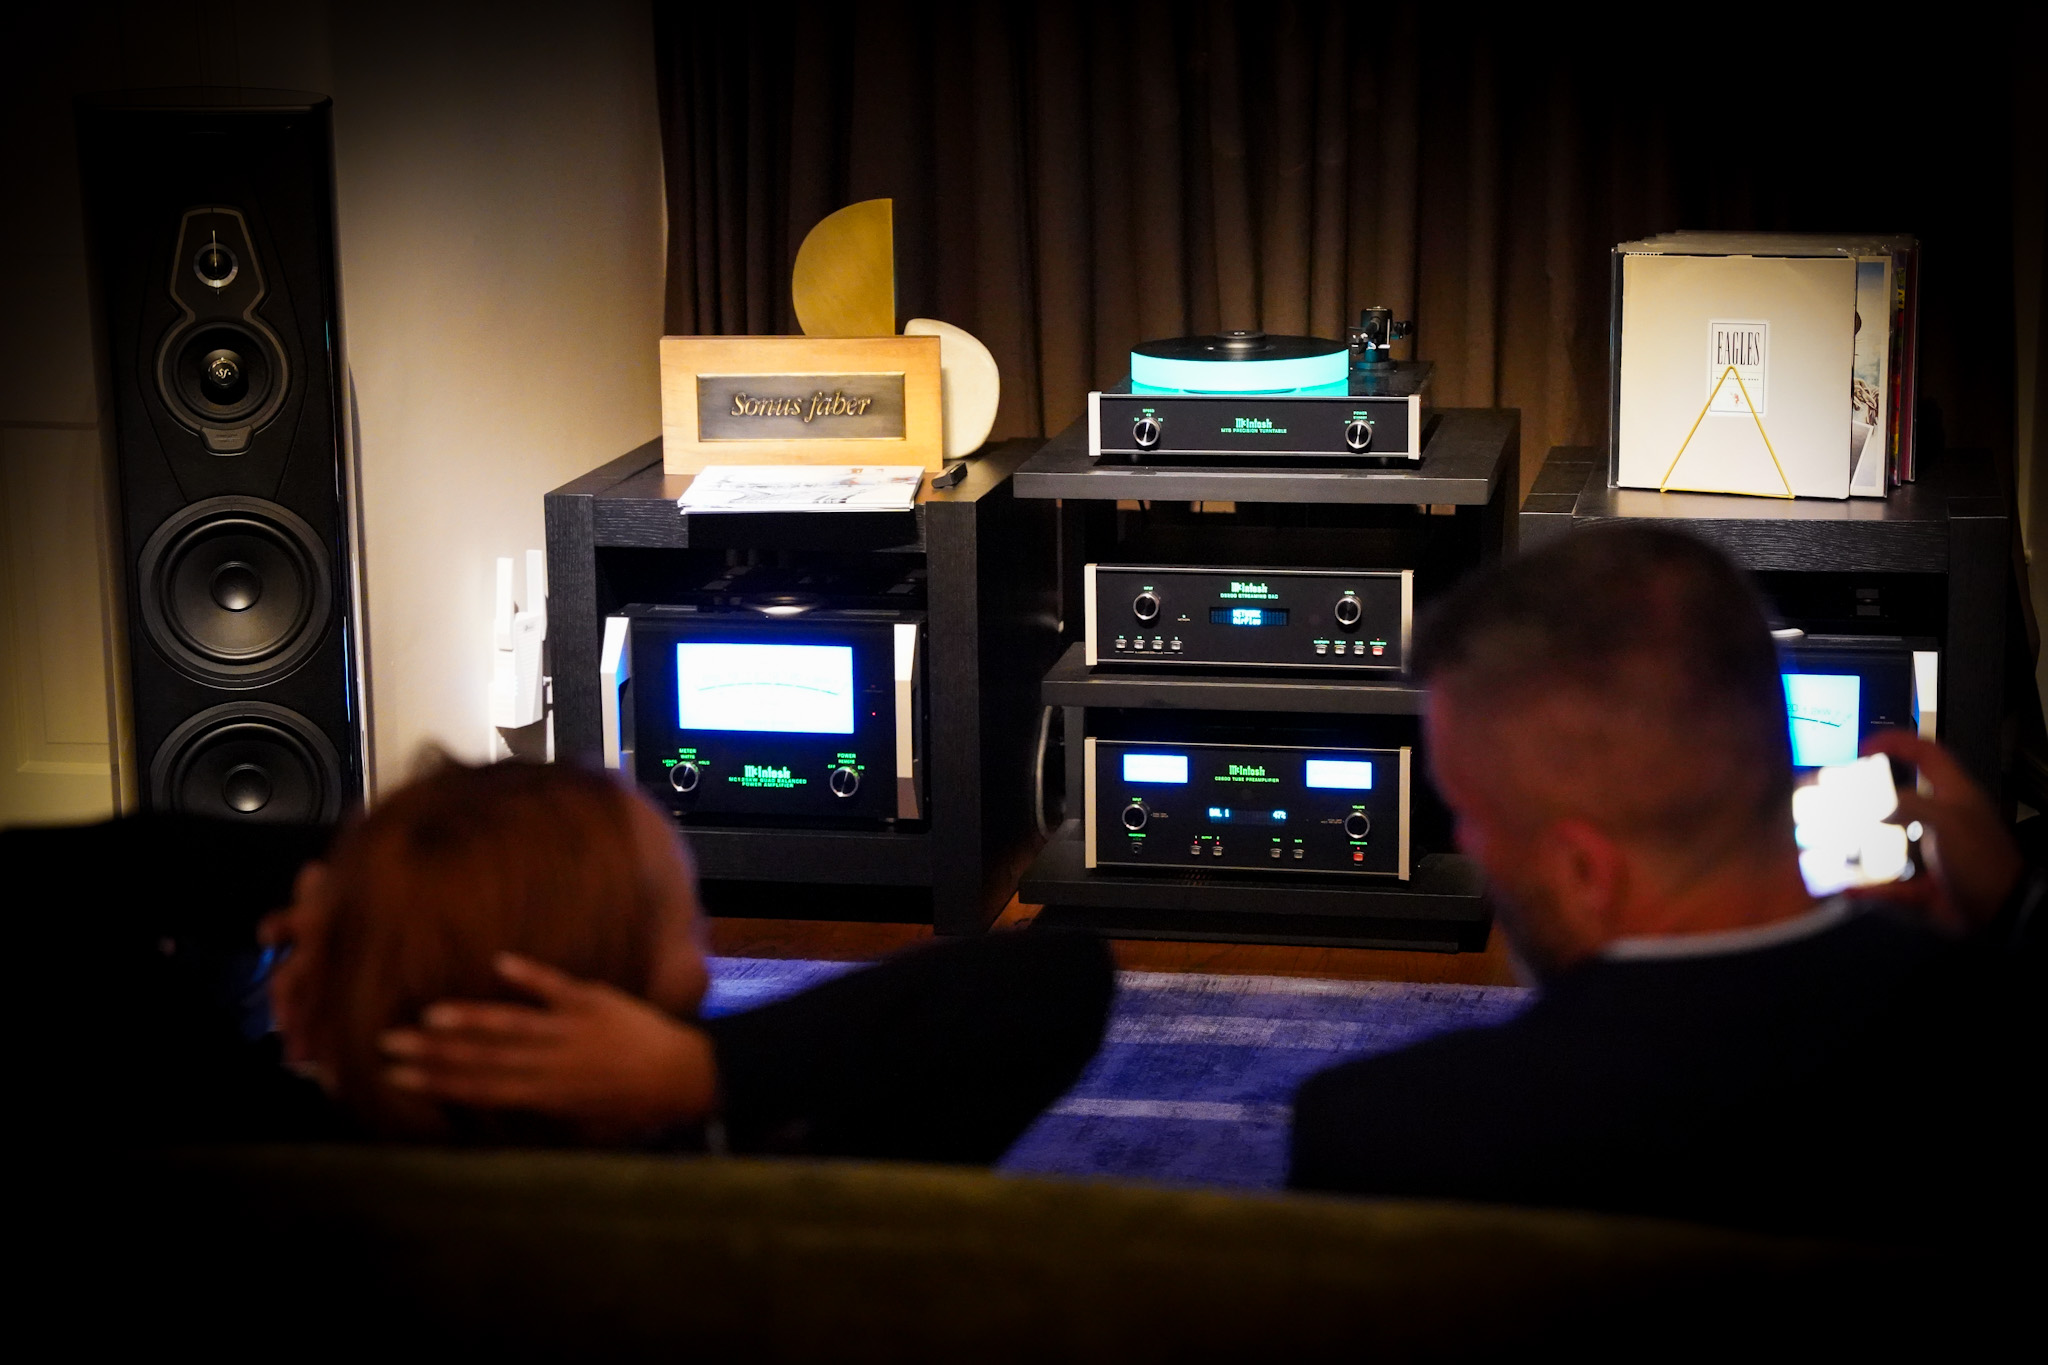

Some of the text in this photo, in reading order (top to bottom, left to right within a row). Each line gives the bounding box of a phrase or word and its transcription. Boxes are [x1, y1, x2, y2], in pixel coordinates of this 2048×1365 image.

[1717, 331, 1760, 366] EAGLES
[731, 390, 872, 424] Sonus faber
[1235, 418, 1272, 428] McIntosh
[1231, 582, 1268, 593] McIntosh
[744, 765, 791, 778] McIntosh
[1229, 765, 1265, 776] McIntosh
